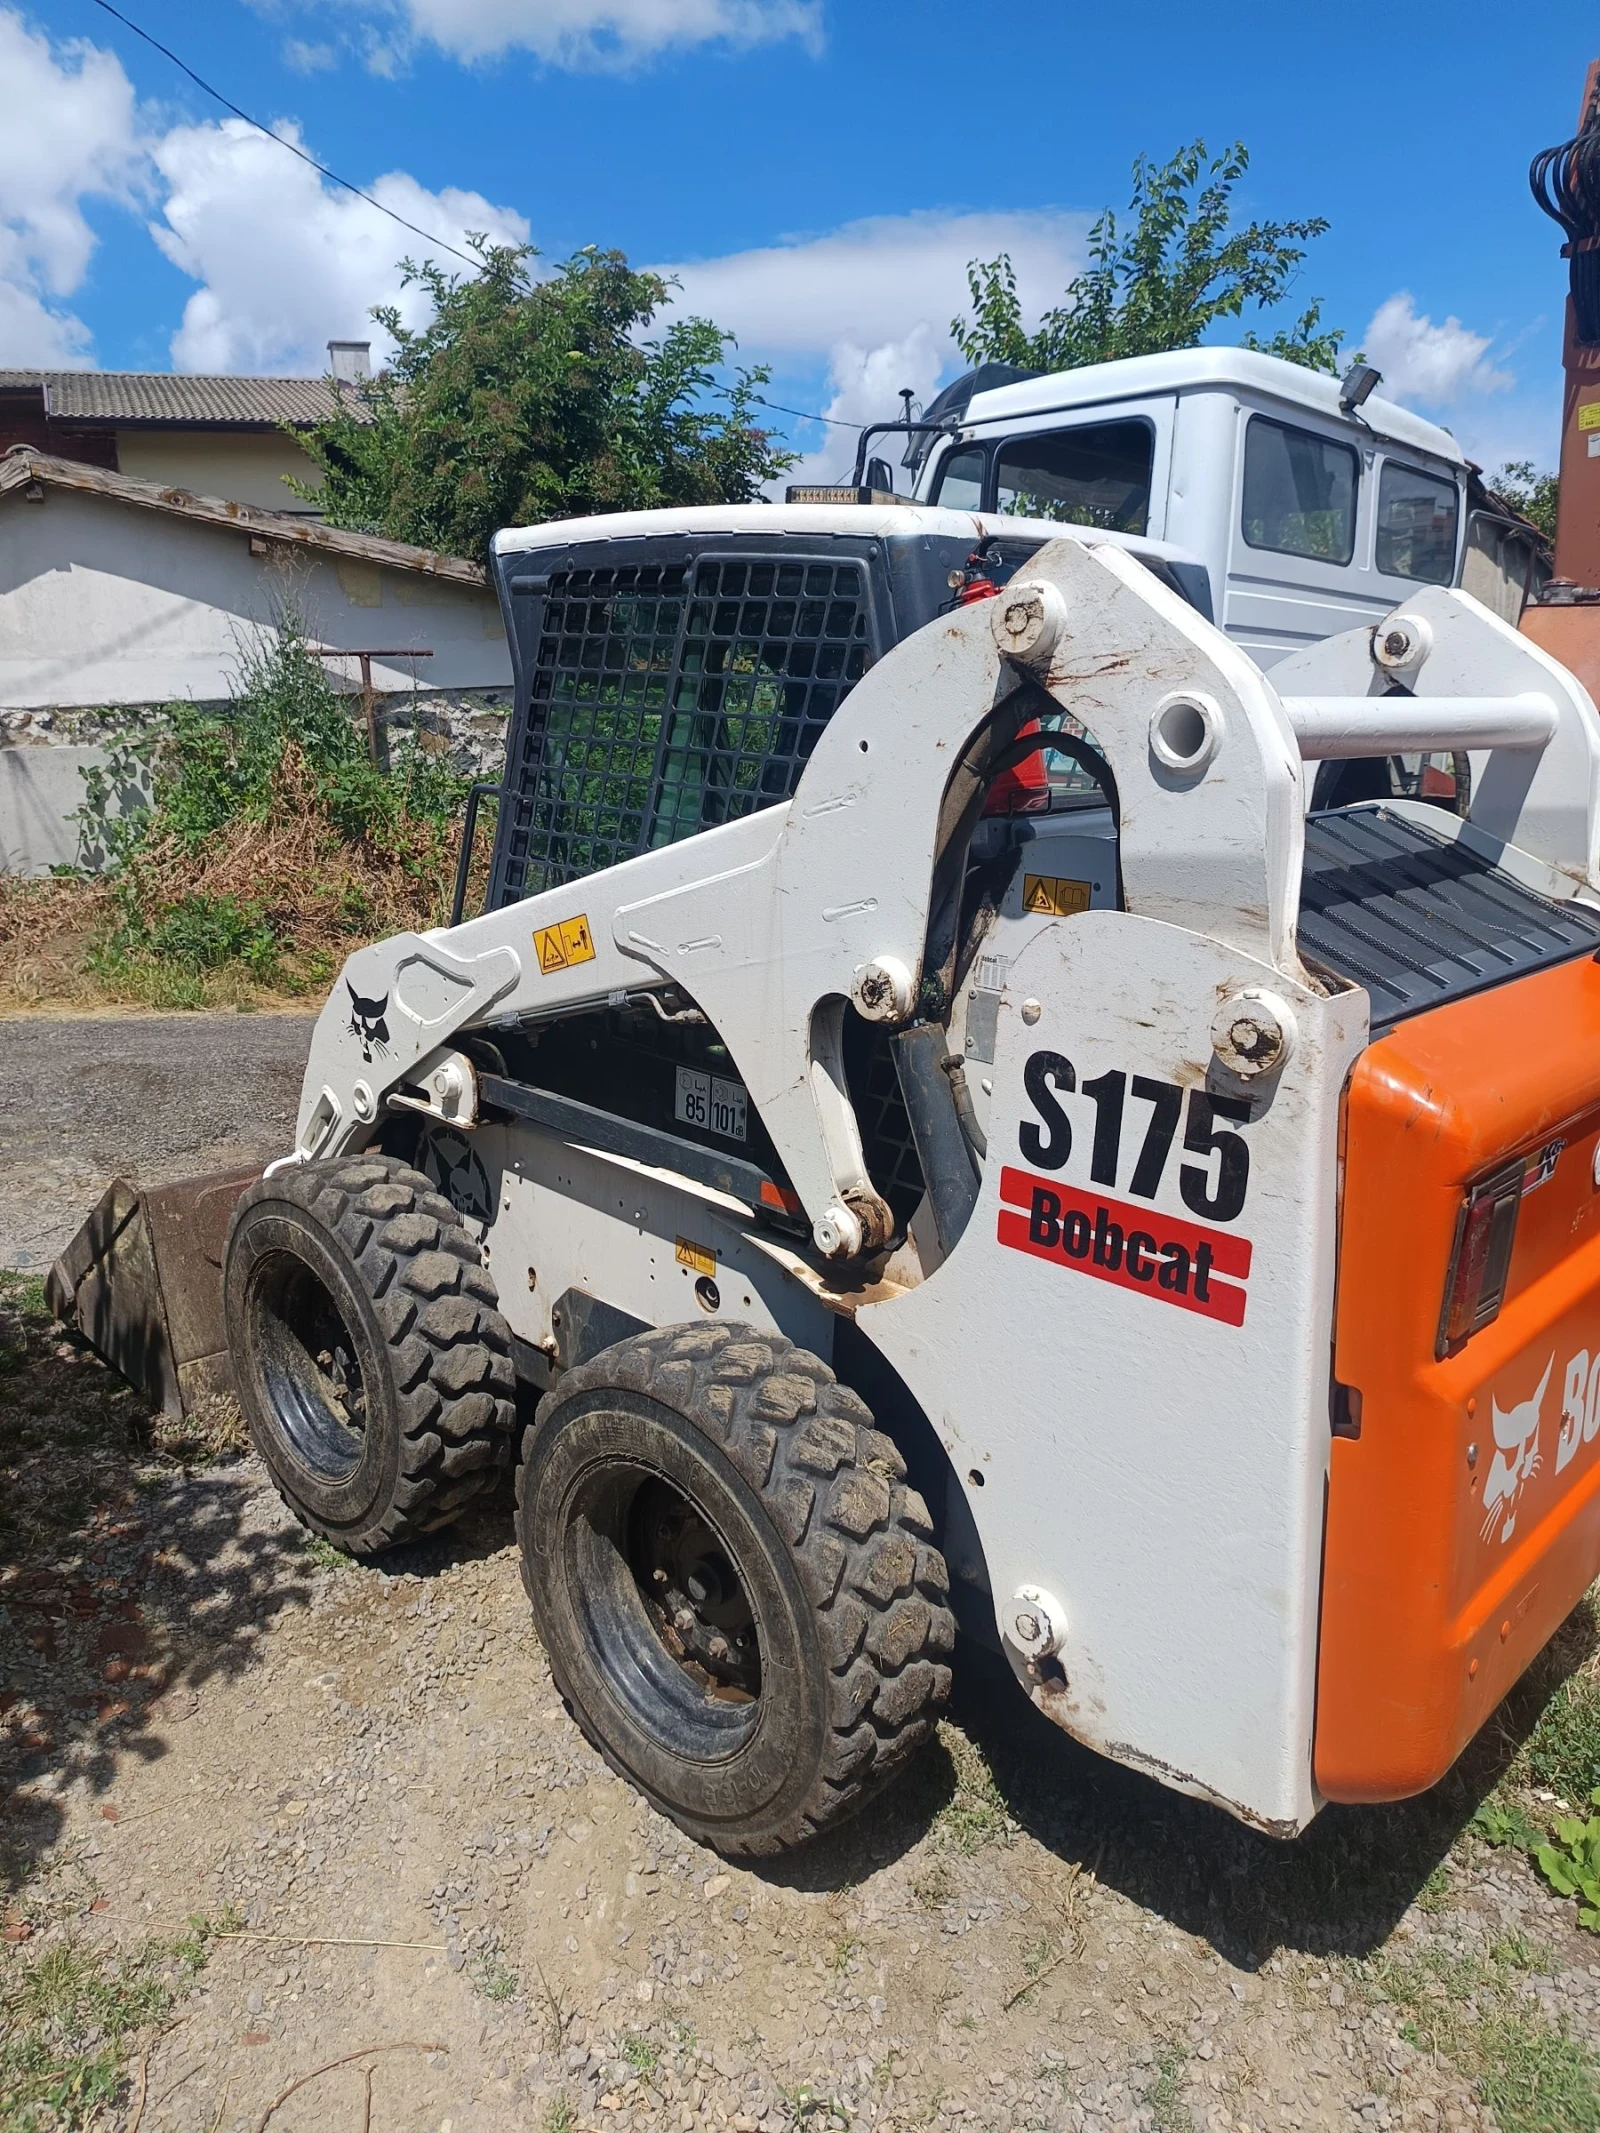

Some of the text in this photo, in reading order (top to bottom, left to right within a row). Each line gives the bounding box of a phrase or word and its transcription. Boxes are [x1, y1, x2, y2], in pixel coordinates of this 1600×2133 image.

[685, 1093, 706, 1123] 85
[713, 1102, 736, 1135] 101
[1019, 1050, 1251, 1222] S175
[1029, 1186, 1214, 1303] Bobcat
